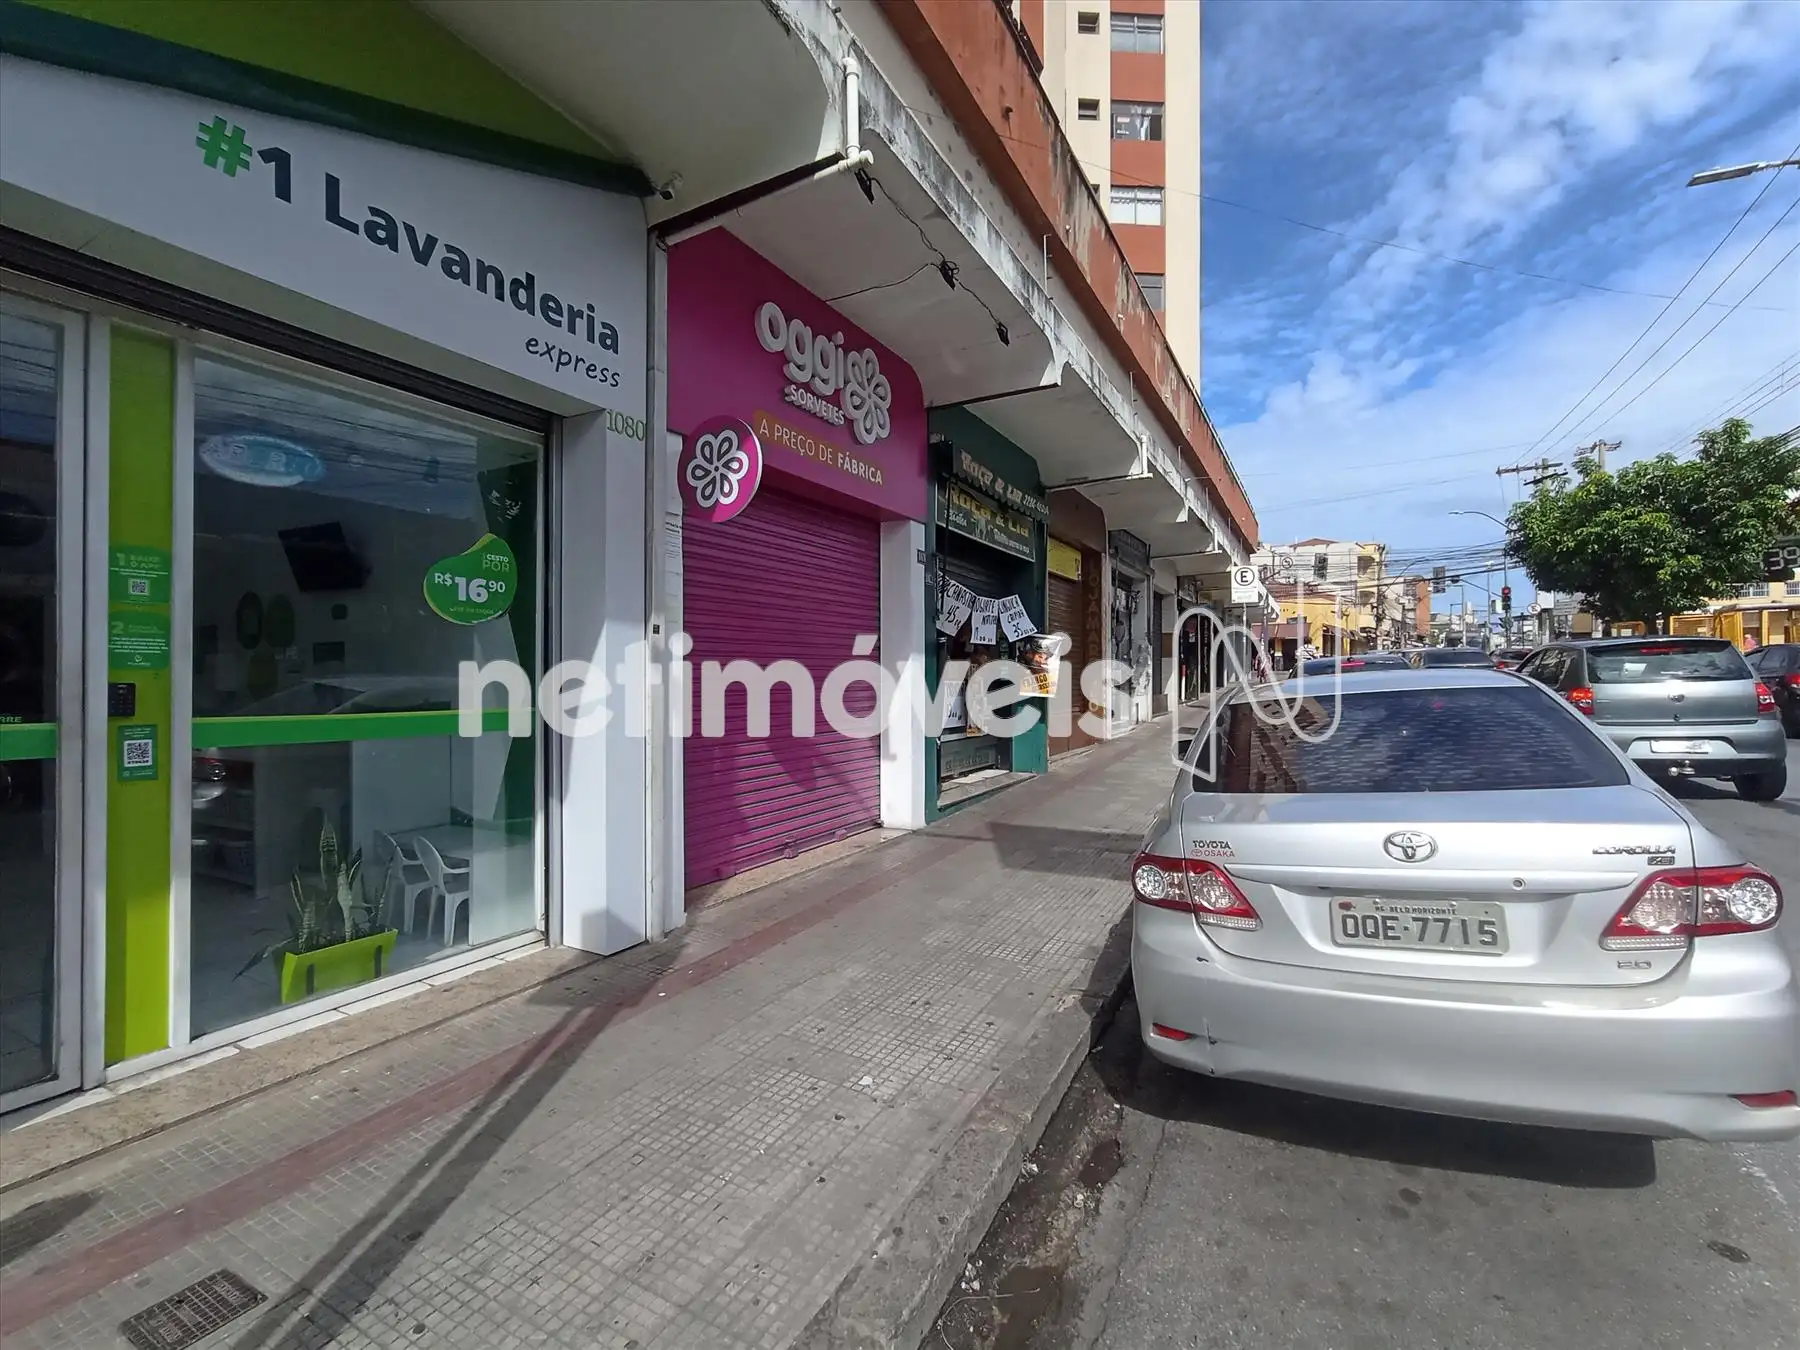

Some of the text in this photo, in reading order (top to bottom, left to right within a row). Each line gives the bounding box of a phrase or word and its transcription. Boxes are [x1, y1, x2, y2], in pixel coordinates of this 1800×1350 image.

[196, 115, 619, 355] #1 Lavanderia
[525, 335, 620, 388] express
[755, 302, 844, 396] oggi
[785, 384, 845, 425] SORVETES
[606, 411, 645, 441] 1080
[759, 419, 883, 485] A PREÇO DE FÁBRICA
[482, 559, 509, 572] POR
[487, 553, 509, 563] CESTO
[434, 572, 453, 587] R$
[1240, 570, 1249, 583] E
[1192, 840, 1231, 849] TOYOTA
[1203, 849, 1235, 857] OSAKA
[1341, 914, 1499, 946] OQE-7715
